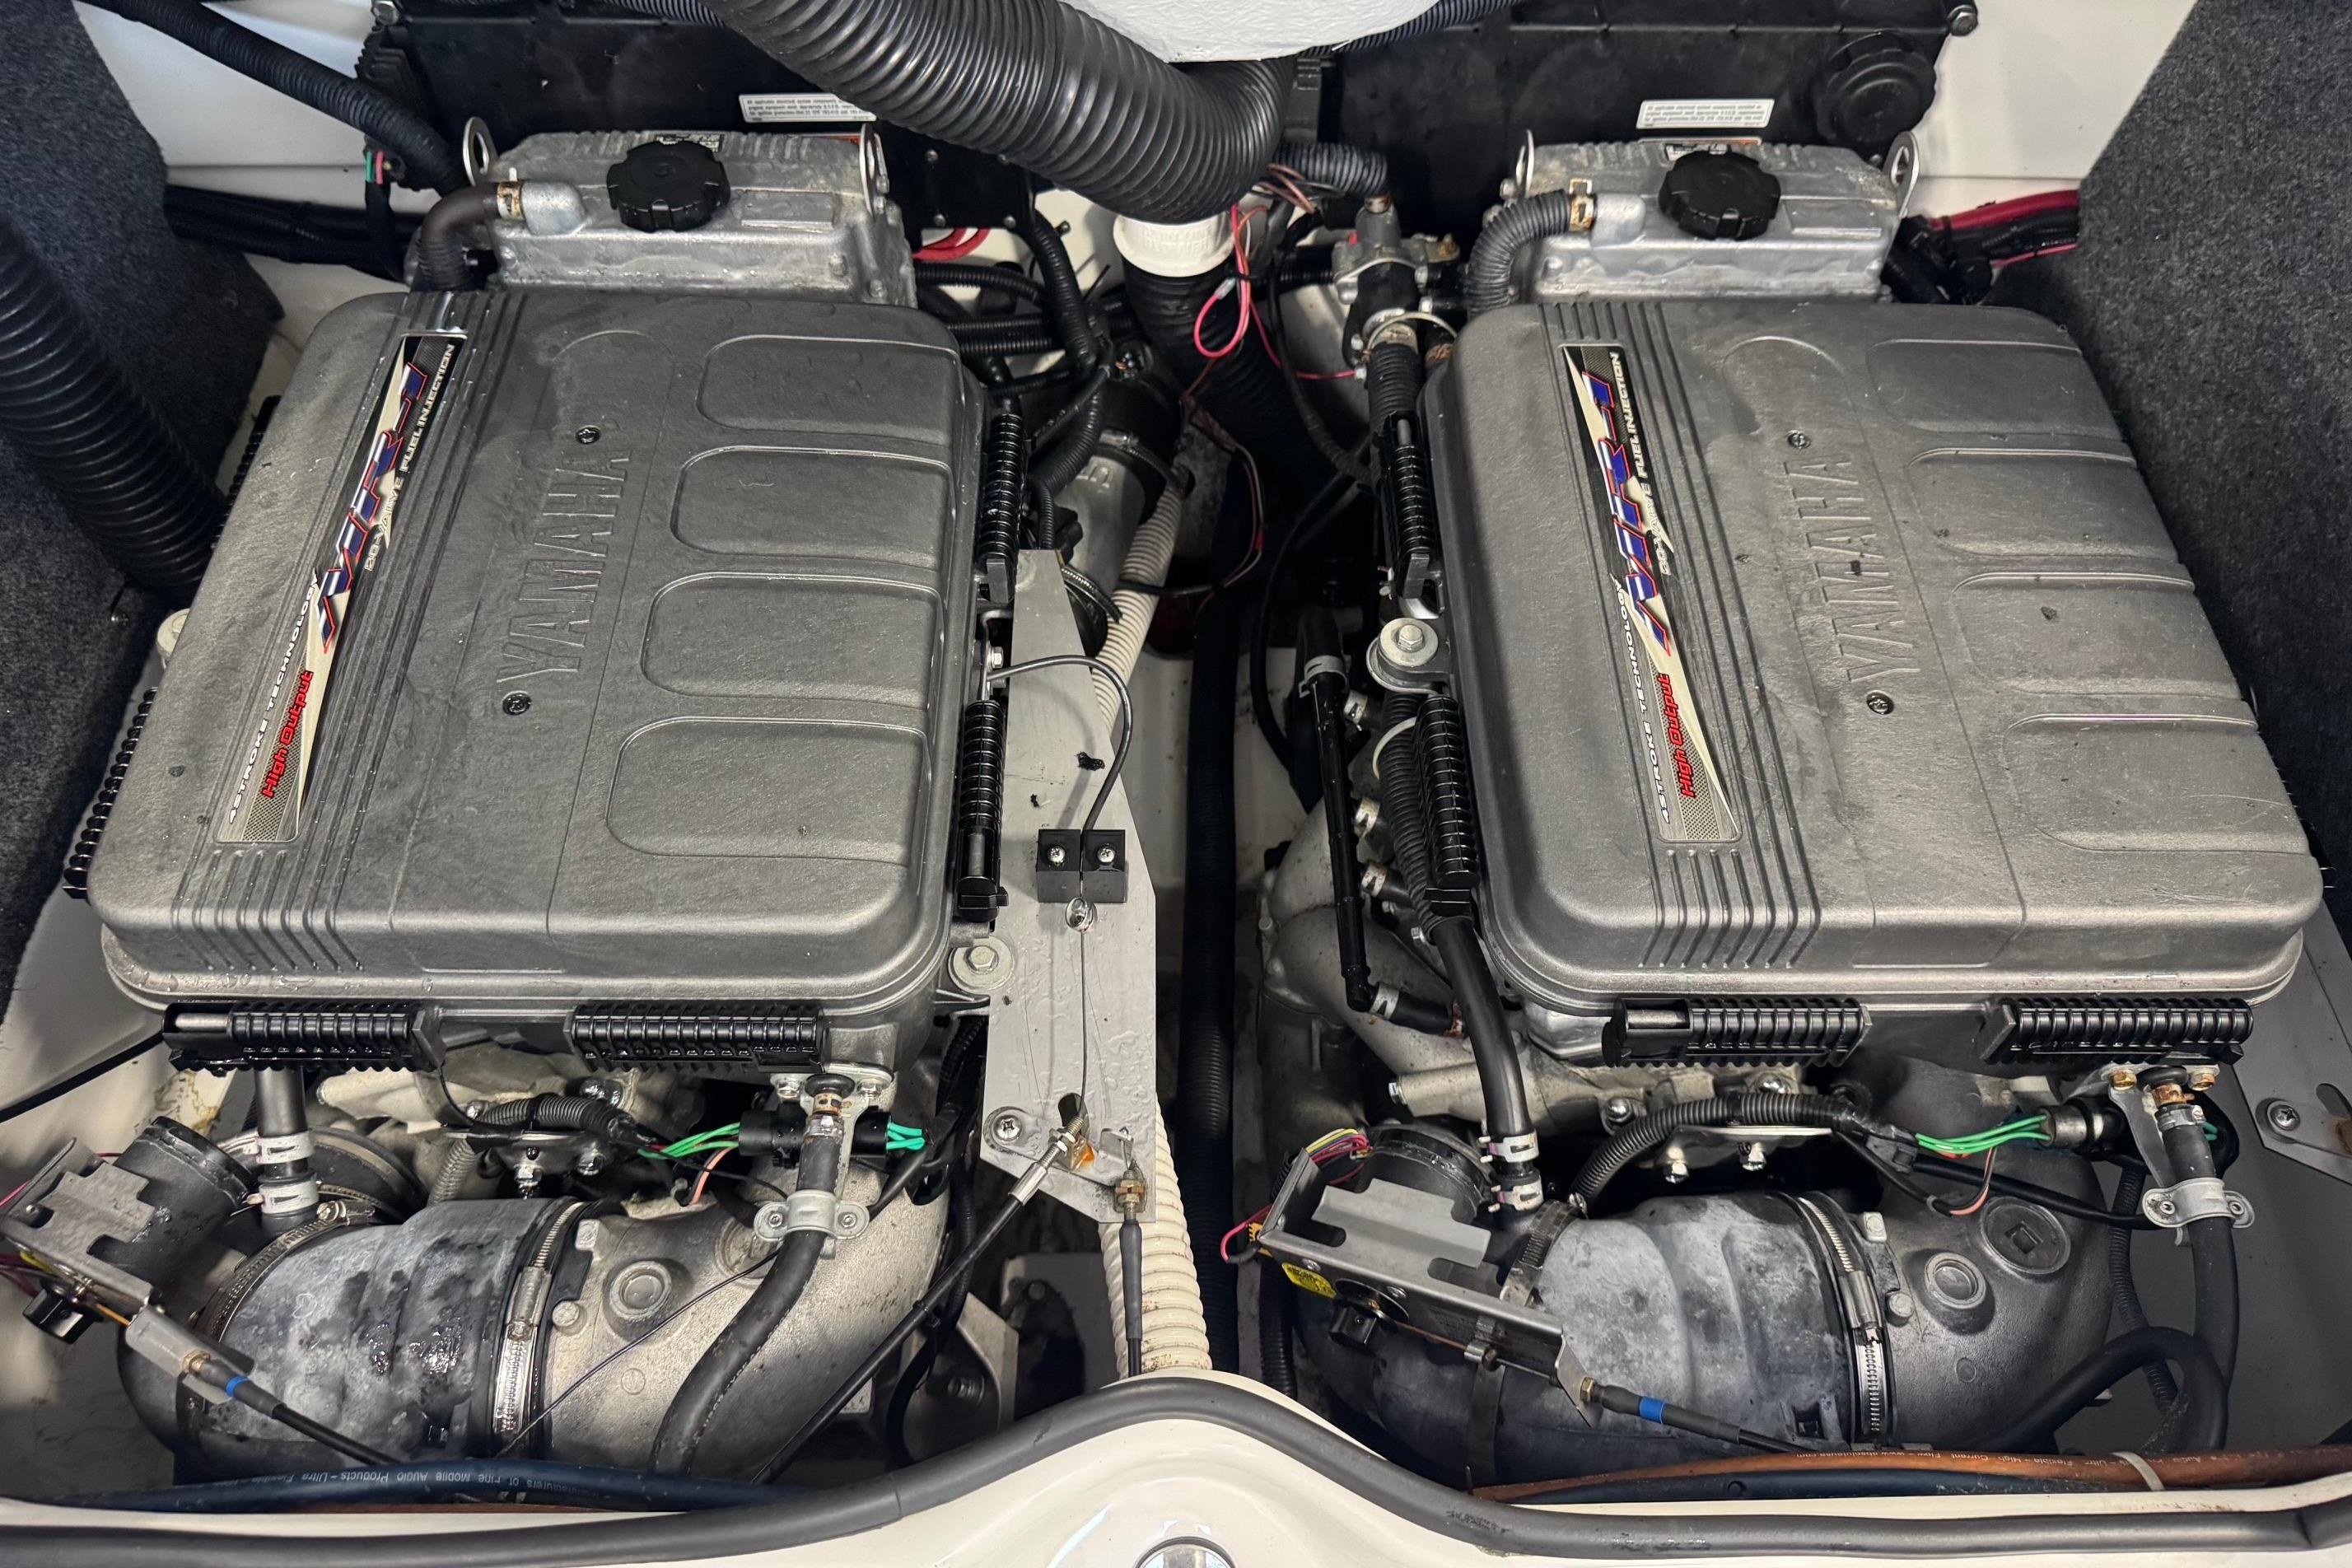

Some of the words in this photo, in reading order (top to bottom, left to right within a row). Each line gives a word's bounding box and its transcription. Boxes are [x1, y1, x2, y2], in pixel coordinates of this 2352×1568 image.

[399, 432, 423, 473] FUEL
[417, 343, 455, 427] INJECTION
[1609, 351, 1637, 434] INJECTION
[1630, 434, 1650, 479] FUEL
[496, 450, 631, 683] YAMAHA
[1783, 454, 1920, 683] YAMAHA
[266, 573, 319, 712] TECHNOLOGY
[1613, 578, 1648, 714] TECHNOLOGY
[261, 748, 288, 799] High
[278, 670, 314, 746] Output
[1658, 672, 1685, 746] Output
[1673, 749, 1695, 799] High
[301, 1472, 329, 1483] Ultra
[340, 1471, 390, 1483] Products
[397, 1471, 428, 1483] Audio
